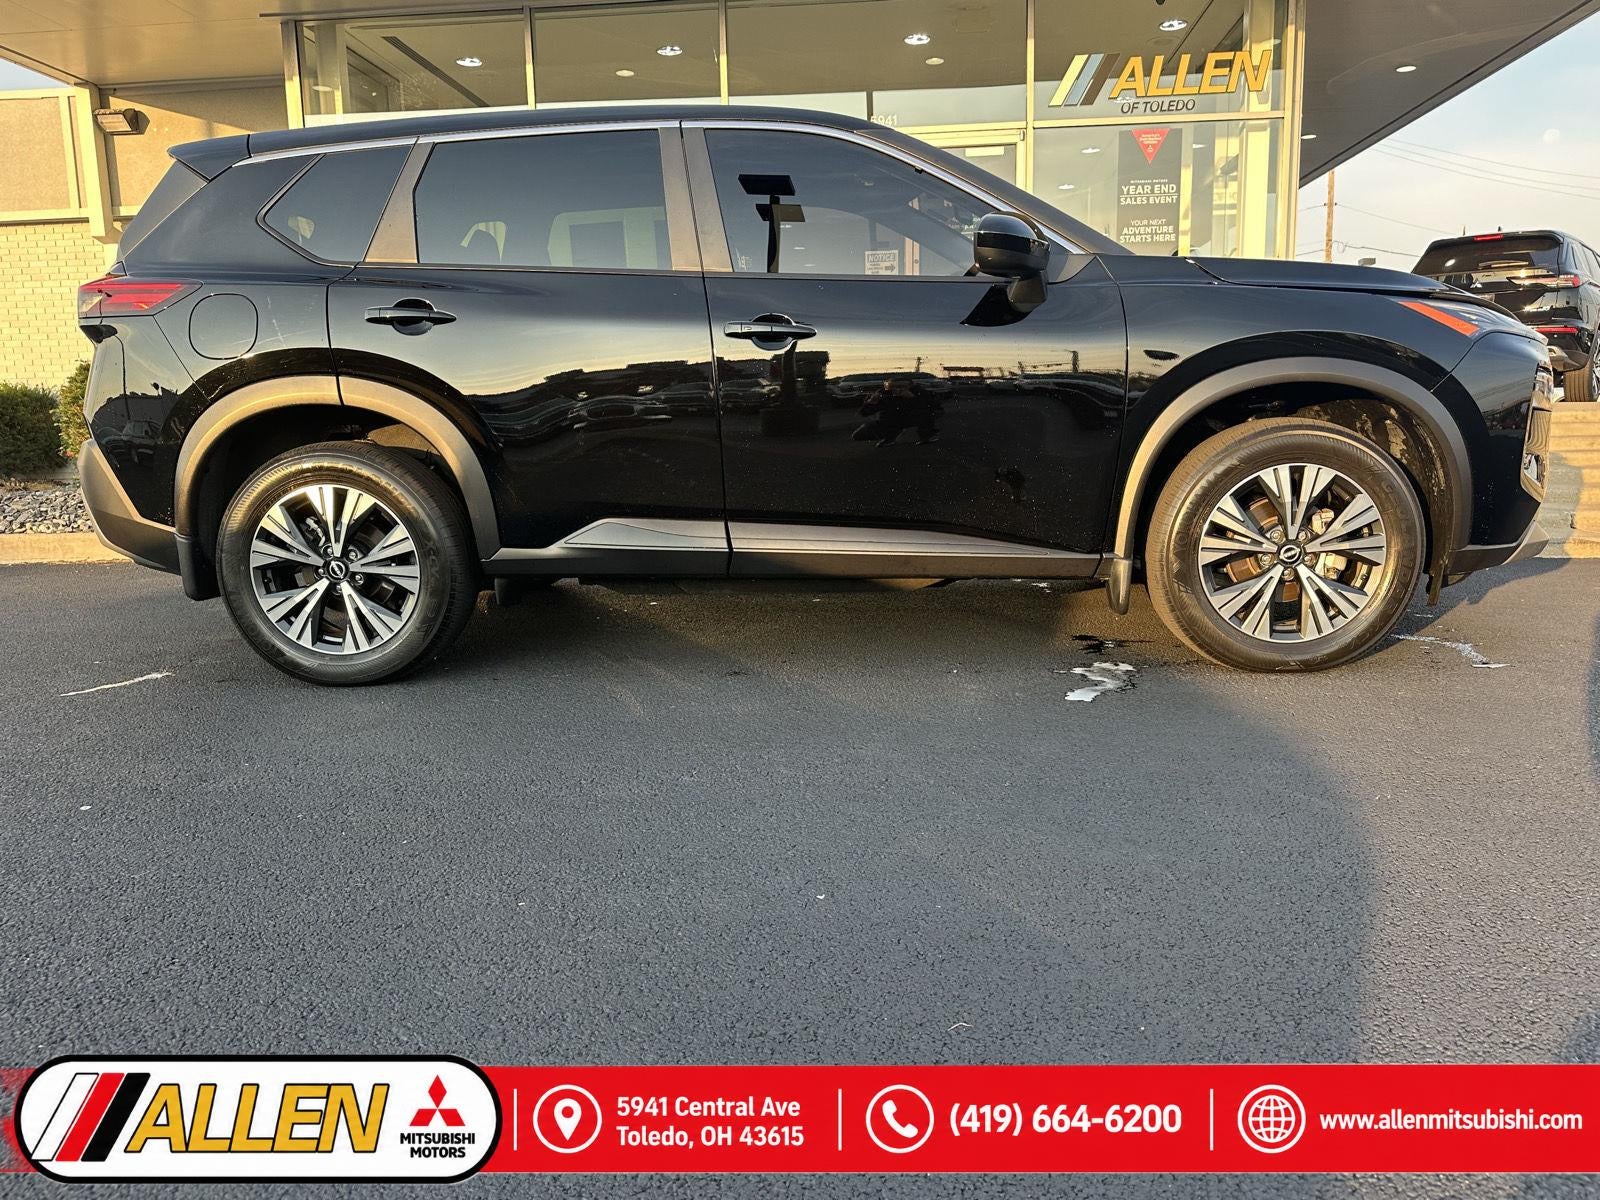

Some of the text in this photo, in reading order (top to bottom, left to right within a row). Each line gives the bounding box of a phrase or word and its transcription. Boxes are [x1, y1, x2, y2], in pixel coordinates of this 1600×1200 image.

[1108, 50, 1273, 100] ALLEN
[1121, 99, 1196, 114] OF TOLEDO
[1121, 183, 1177, 195] YEAR END
[1120, 195, 1178, 205] SALES EVENT
[1122, 225, 1174, 235] ADVENTURE
[1120, 233, 1176, 243] STARTS HERE
[868, 253, 896, 263] NOTICE
